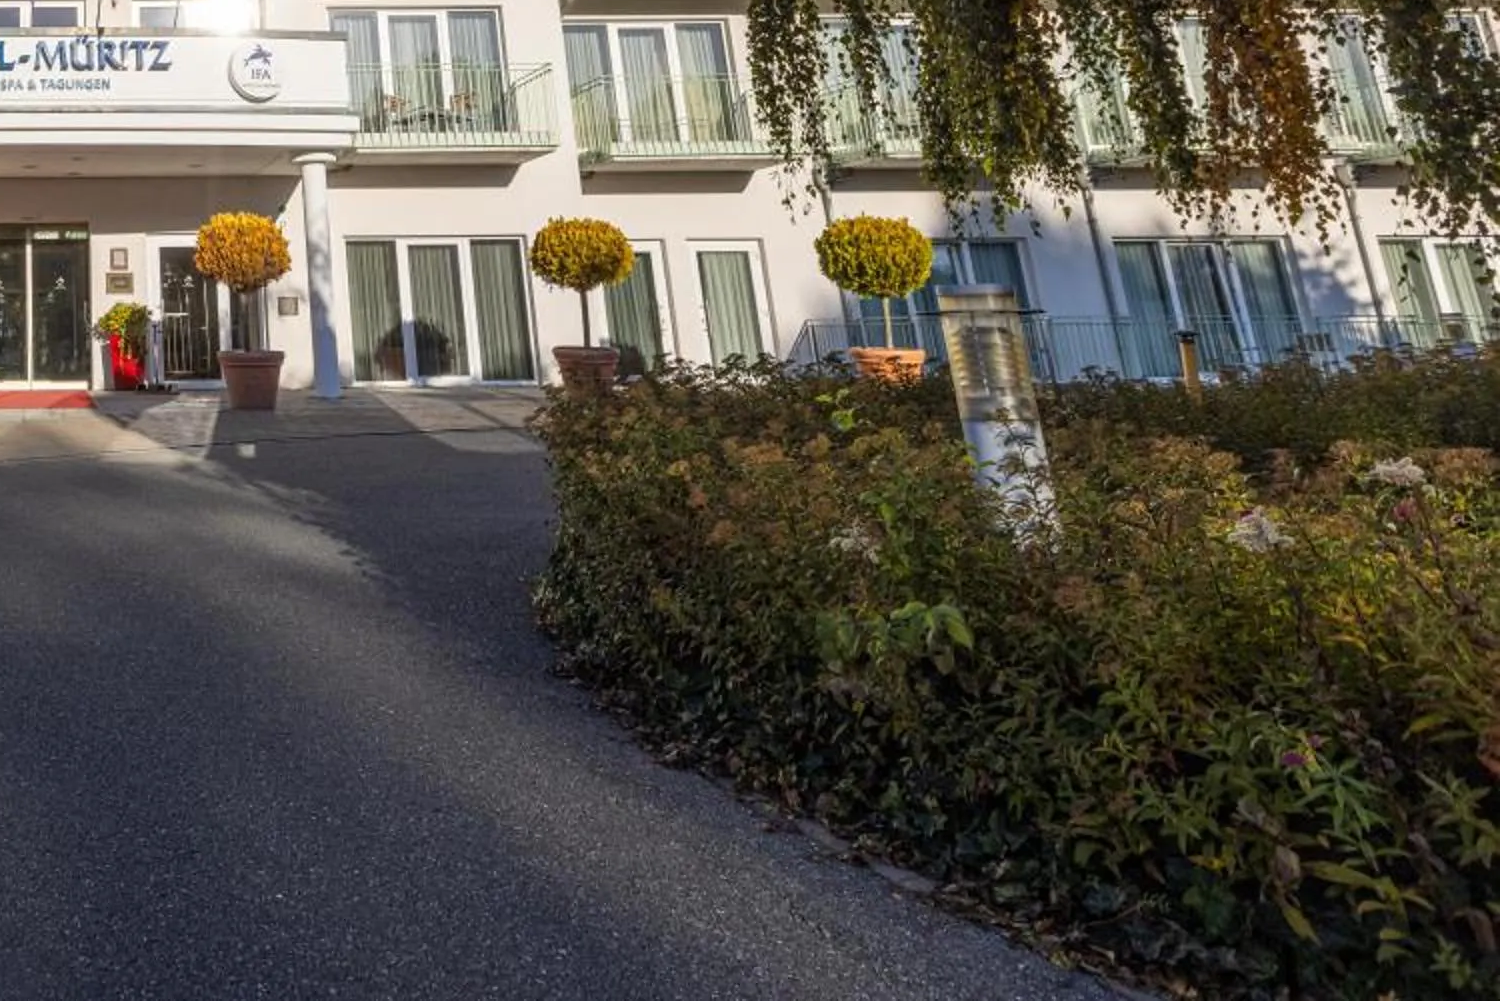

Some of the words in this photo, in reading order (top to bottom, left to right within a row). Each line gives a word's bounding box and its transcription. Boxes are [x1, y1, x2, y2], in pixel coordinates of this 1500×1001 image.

[251, 68, 271, 80] IFA
[0, 78, 24, 91] SPA
[27, 79, 37, 91] &
[40, 78, 111, 91] TAGUNGEN
